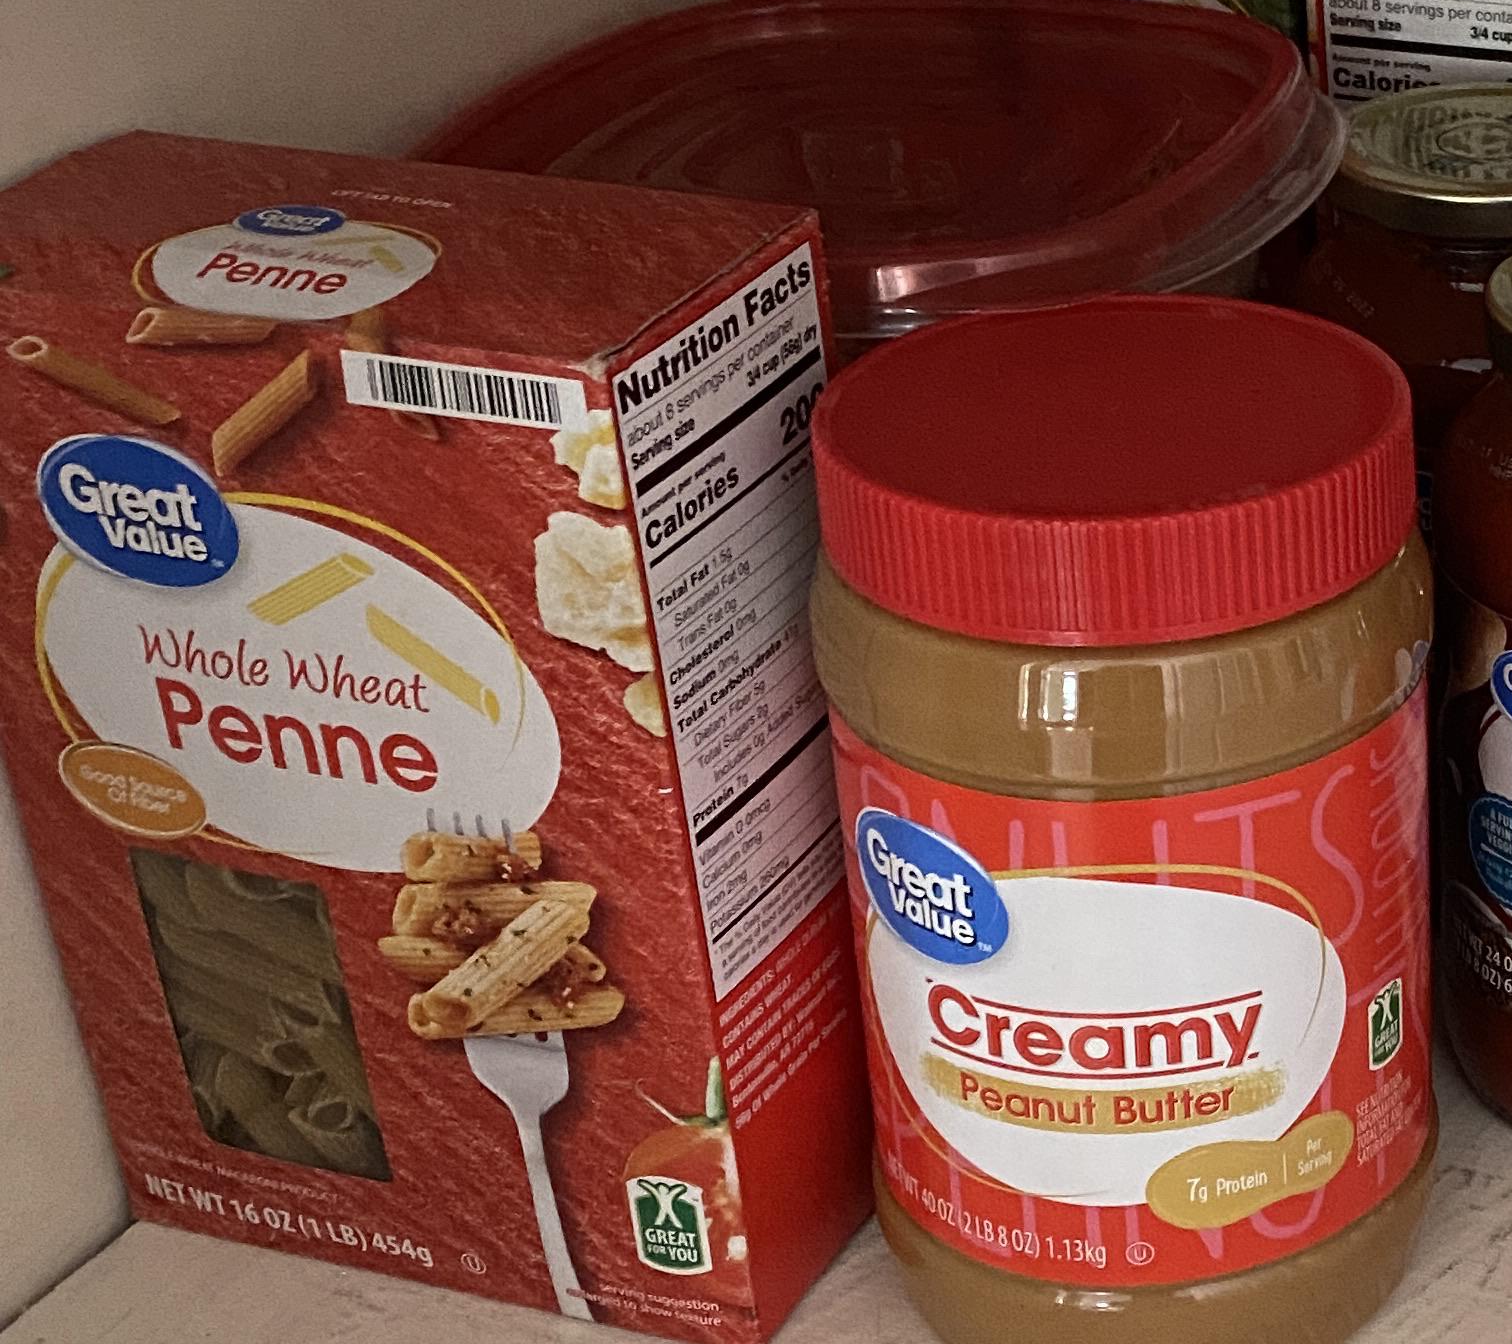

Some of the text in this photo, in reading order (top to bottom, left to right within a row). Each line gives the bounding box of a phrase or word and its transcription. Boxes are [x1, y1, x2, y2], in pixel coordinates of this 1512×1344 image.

[1329, 13, 1402, 32] Serving size
[1385, 1, 1444, 20] servings
[1448, 8, 1470, 22] per
[196, 252, 348, 294] Penne
[617, 260, 812, 414] Nutrition Facts
[58, 463, 200, 531] Great
[644, 466, 739, 549] Calories
[99, 516, 209, 563] Value
[657, 582, 688, 611] Total
[137, 625, 430, 713] Whole Wheat
[669, 624, 735, 686] Cholesterol
[673, 669, 717, 709] Sodium
[156, 676, 439, 792] Penne
[692, 785, 735, 828] Protein
[867, 828, 973, 918] Great
[889, 884, 975, 946] Value
[928, 983, 1264, 1070] Creamy
[961, 1071, 1236, 1126] Peanut Butter
[1187, 1168, 1268, 1204] 7g Protein
[145, 1174, 434, 1268] NET WT 16 OZ LB) 454g
[645, 1228, 697, 1248] GREAT
[938, 1197, 1108, 1269] OZ LB OZ) 1.13kg
[668, 1246, 698, 1263] YOU
